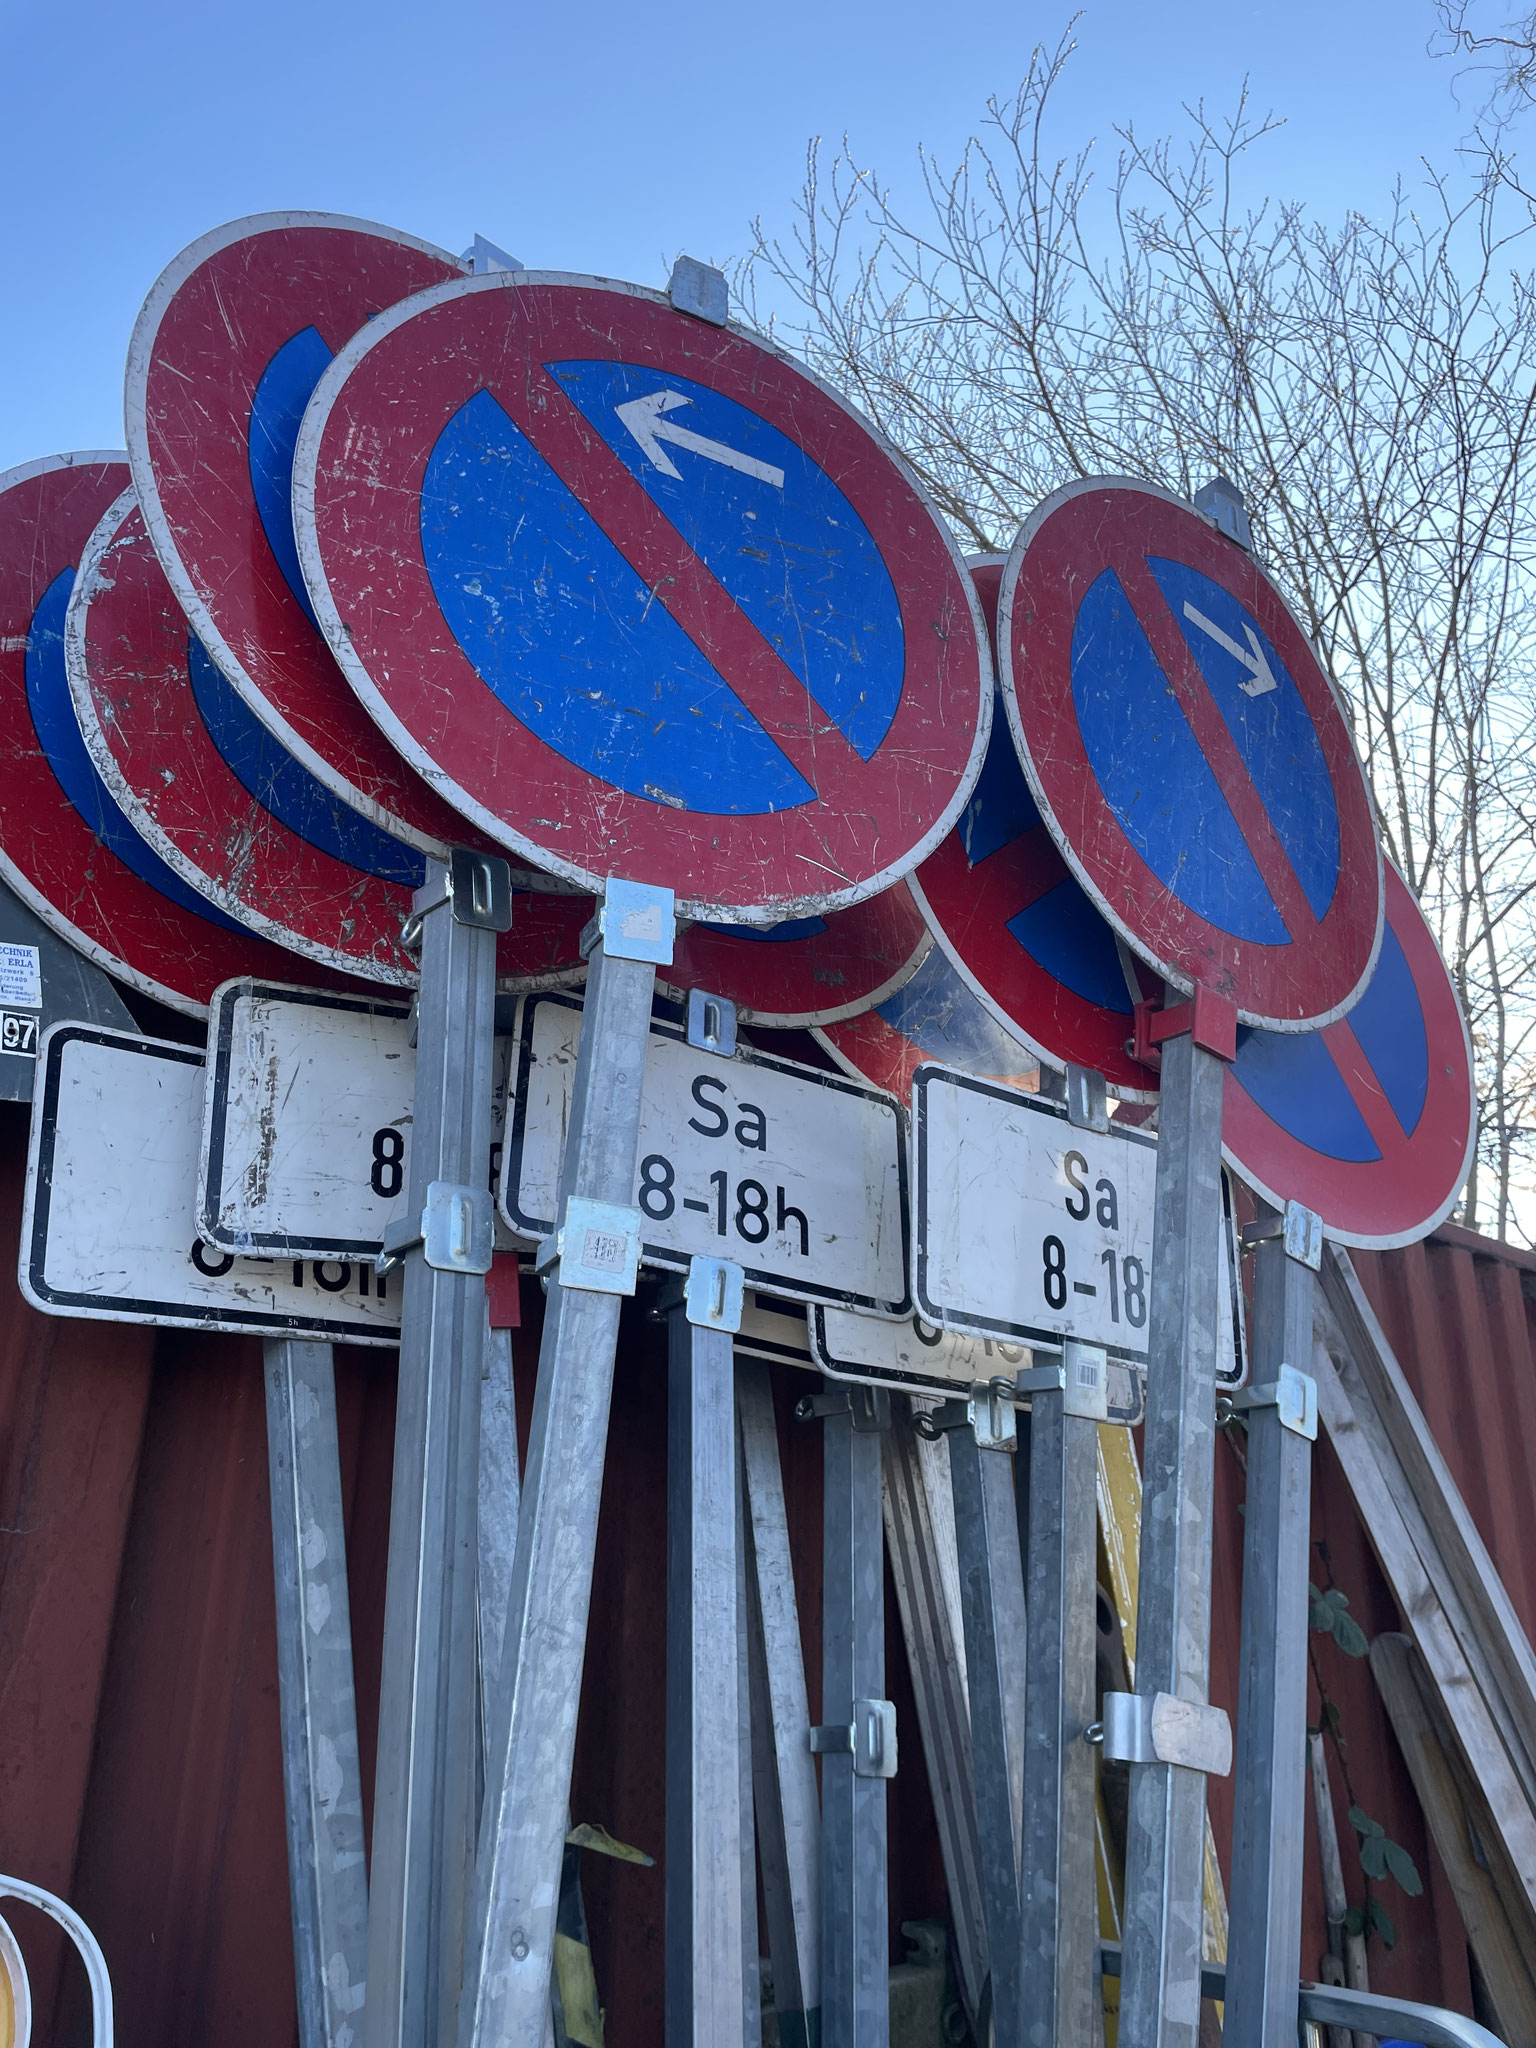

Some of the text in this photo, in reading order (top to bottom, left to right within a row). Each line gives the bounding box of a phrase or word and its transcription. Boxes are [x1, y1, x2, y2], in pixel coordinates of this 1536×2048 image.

[8, 958, 33, 968] ERLA
[3, 1018, 35, 1049] 97
[688, 1075, 766, 1151] Sa
[639, 1155, 809, 1256] 8-18h
[1064, 1150, 1119, 1231] Sa
